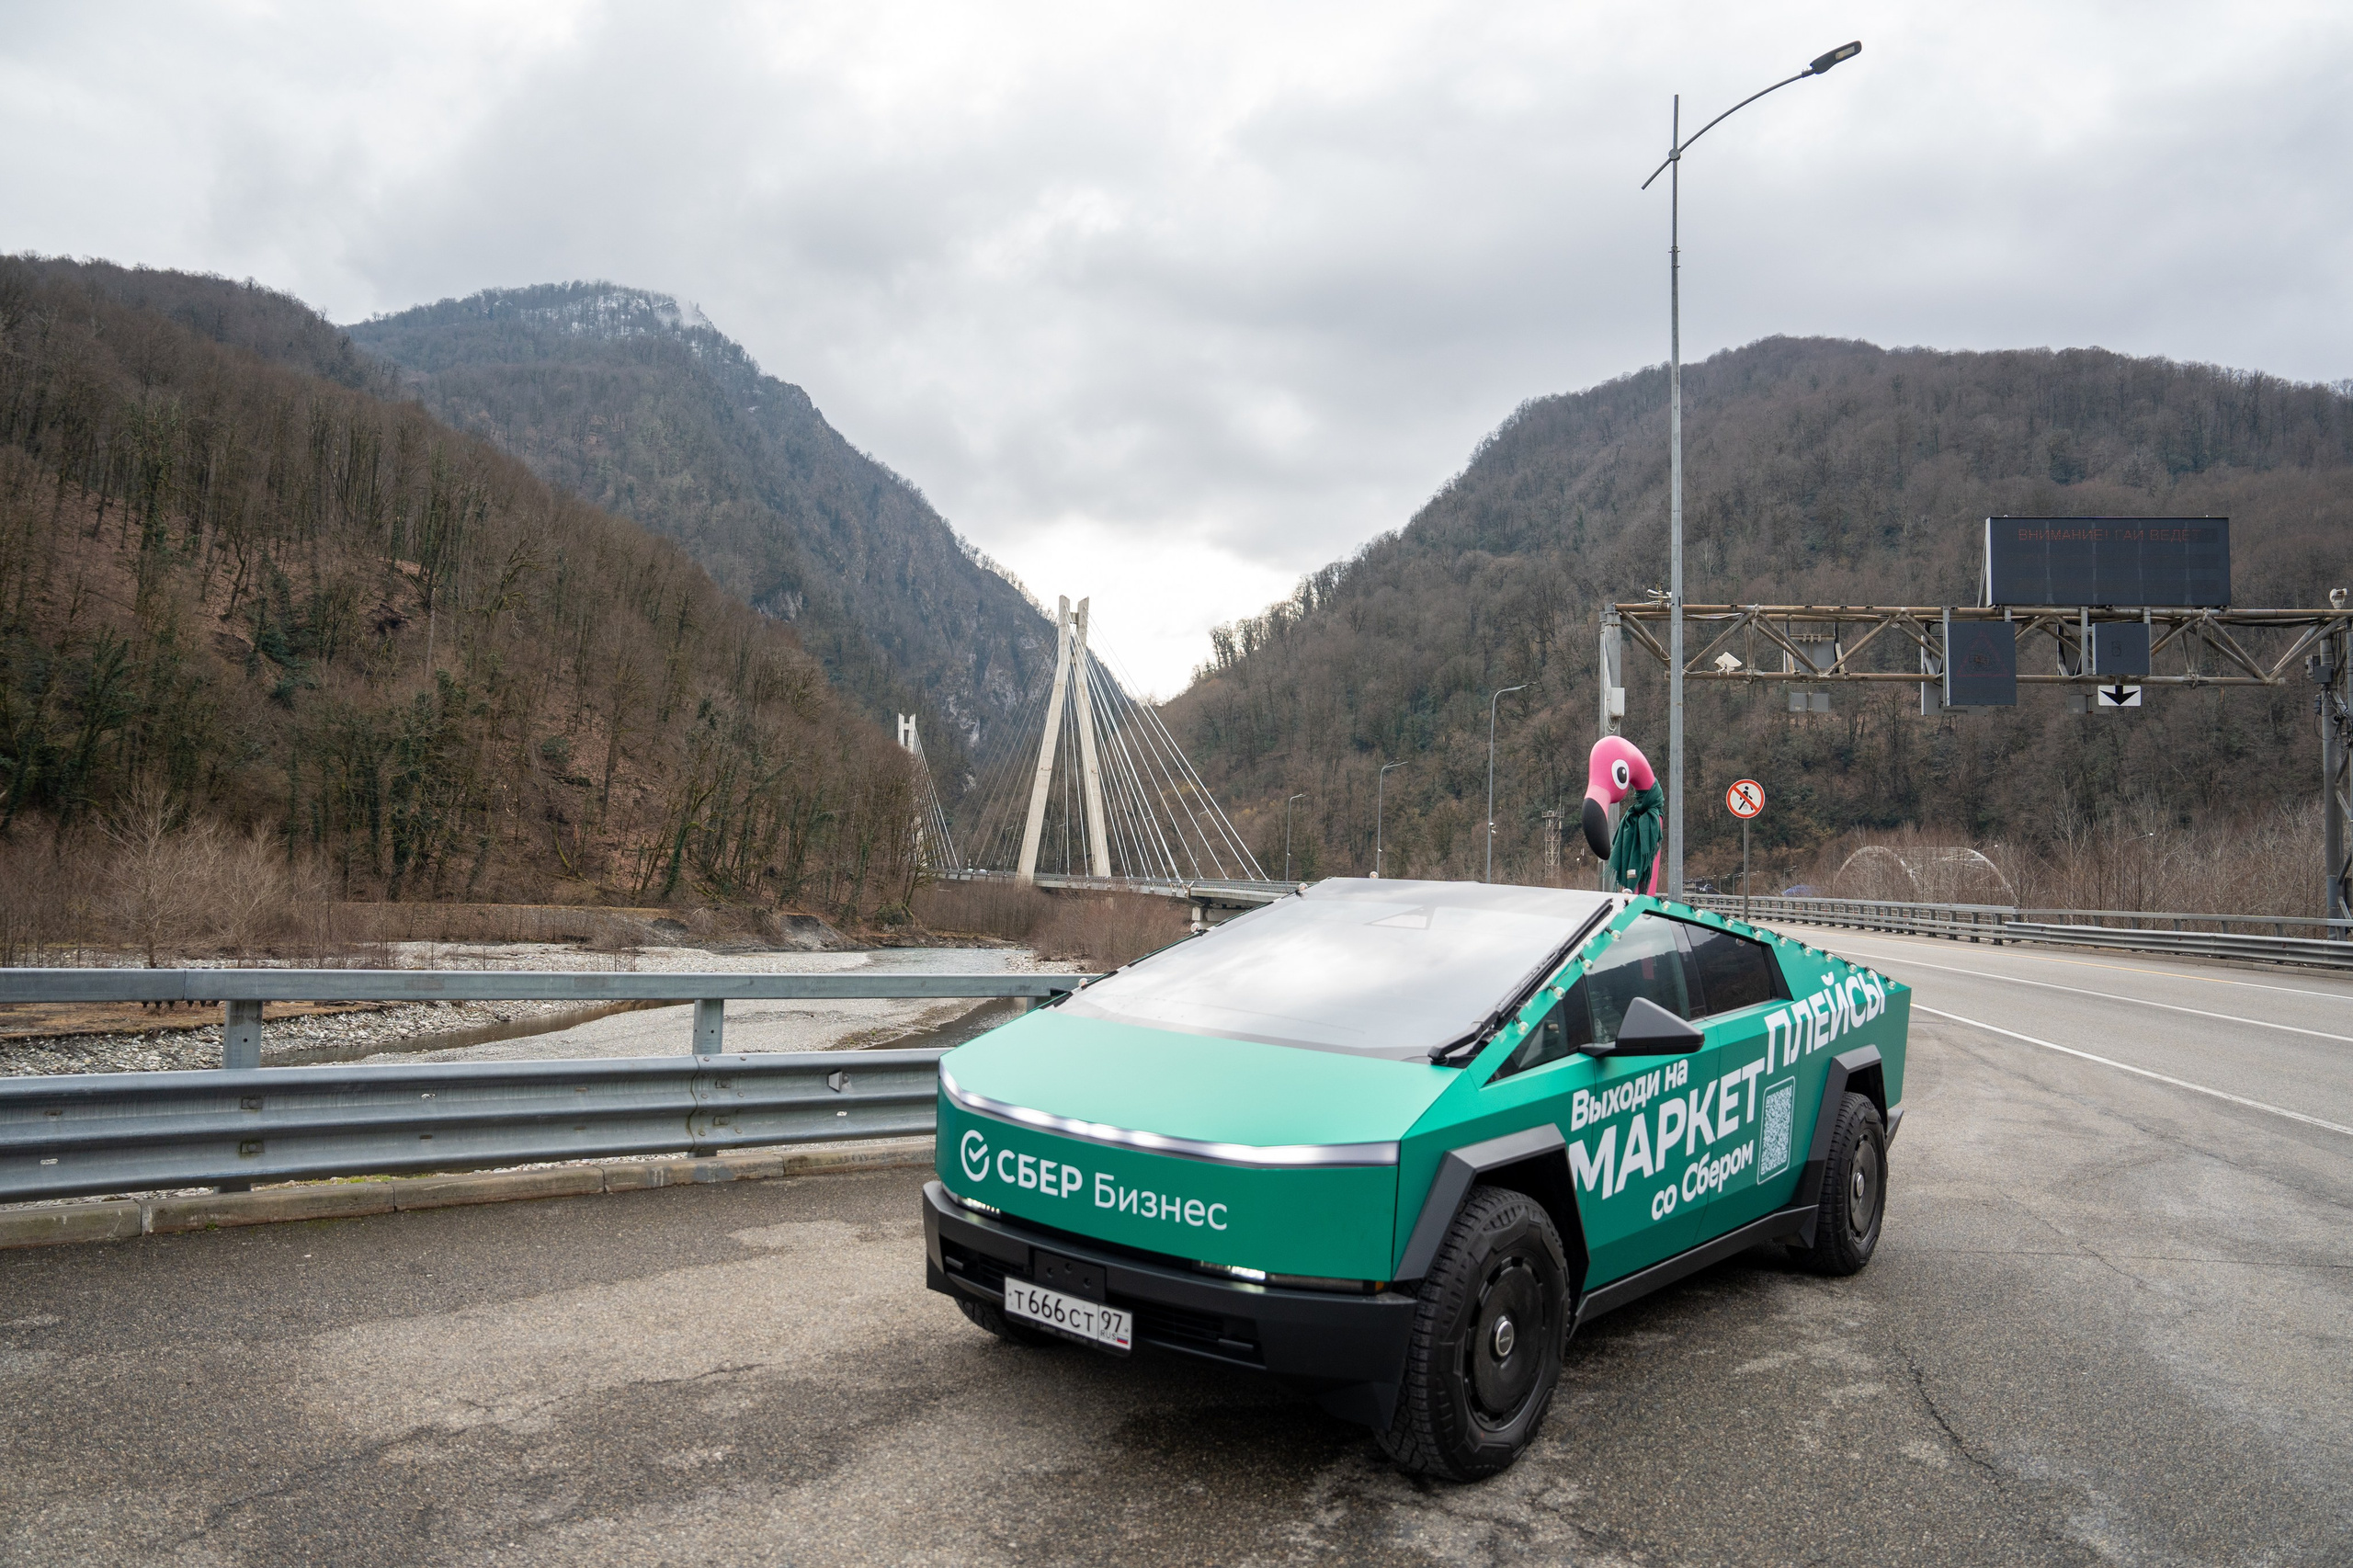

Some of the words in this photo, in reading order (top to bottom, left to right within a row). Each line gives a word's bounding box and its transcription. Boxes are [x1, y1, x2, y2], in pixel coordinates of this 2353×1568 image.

[2018, 528, 2109, 541] ВНИМАНИЕ!
[1764, 971, 1886, 1075] ПЛЕЙСЫ
[1568, 1056, 1766, 1200] МАРКЕТ
[1570, 1070, 1659, 1131] Выходи
[1664, 1059, 1688, 1093] на
[996, 1148, 1084, 1199] СБЕР
[1094, 1172, 1228, 1231] Бизнес
[1651, 1183, 1677, 1221] со
[1681, 1140, 1754, 1204] Сбером
[1099, 1329, 1117, 1341] RUS
